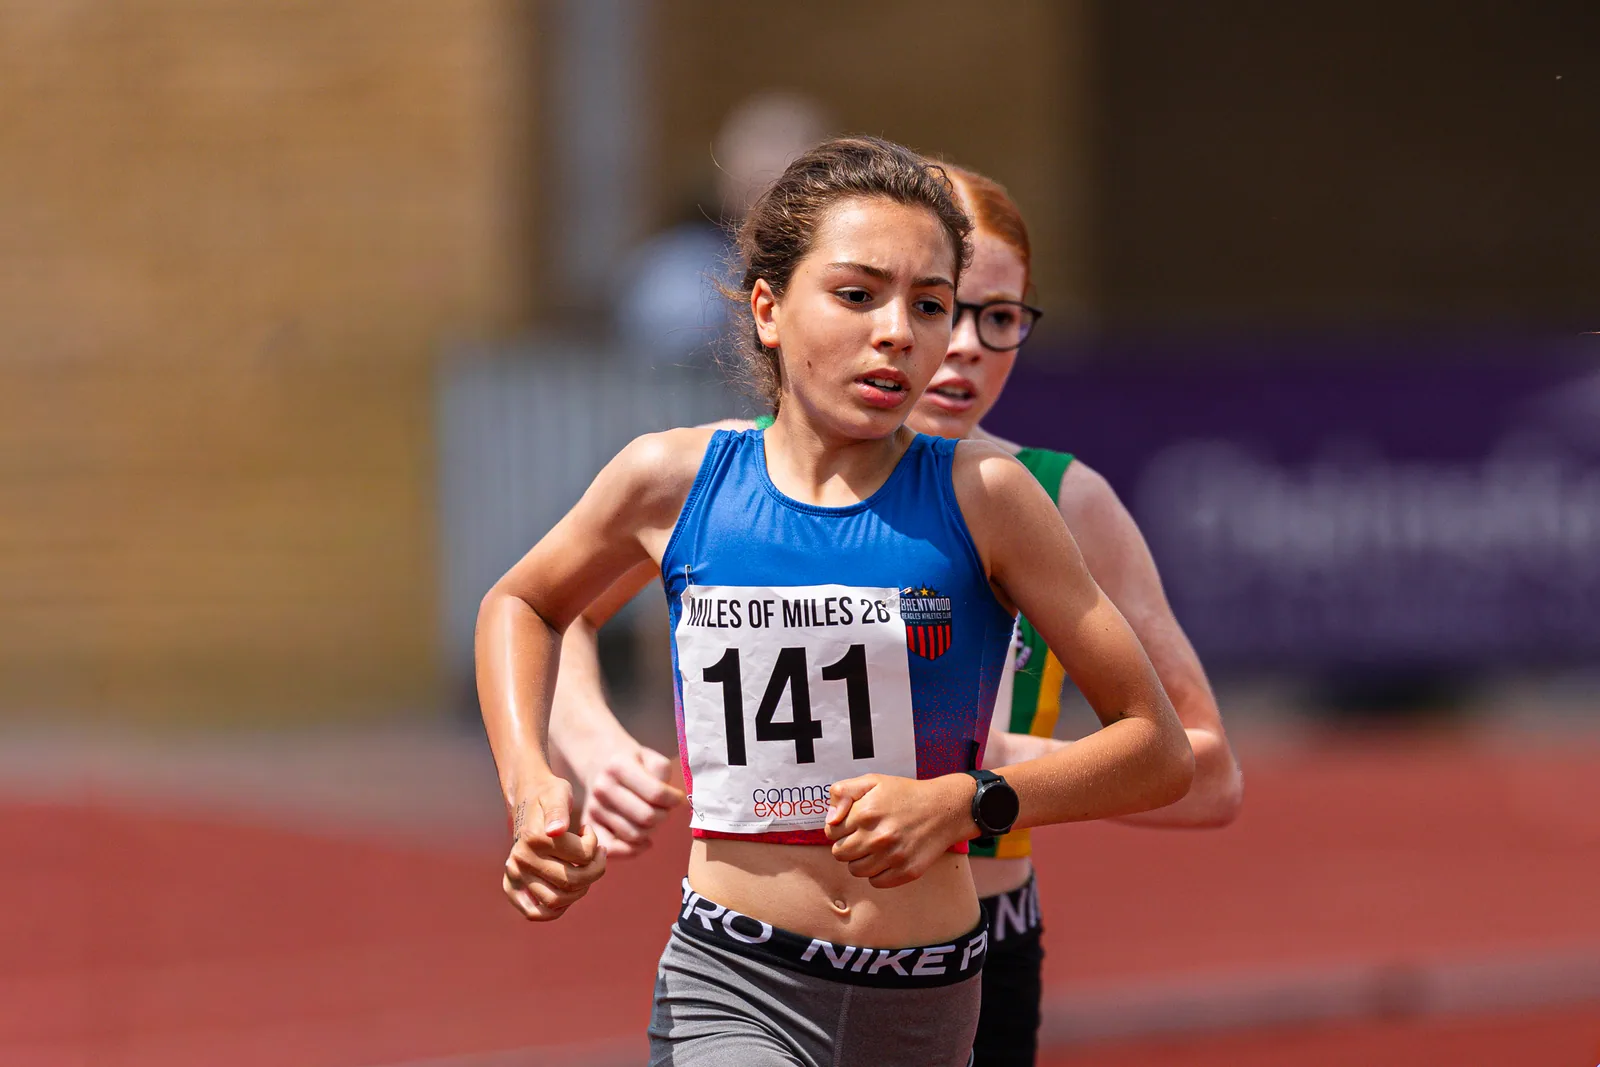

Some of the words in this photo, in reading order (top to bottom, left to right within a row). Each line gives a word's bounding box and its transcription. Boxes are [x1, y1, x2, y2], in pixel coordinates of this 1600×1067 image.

[687, 598, 742, 628] MILES
[749, 599, 775, 628] OF
[783, 596, 854, 628] MILES
[861, 599, 890, 624] 26
[900, 597, 951, 612] BRENTWOOD
[922, 612, 942, 620] ATHLETICS
[702, 643, 875, 767] 141
[800, 938, 956, 976] NIKE
